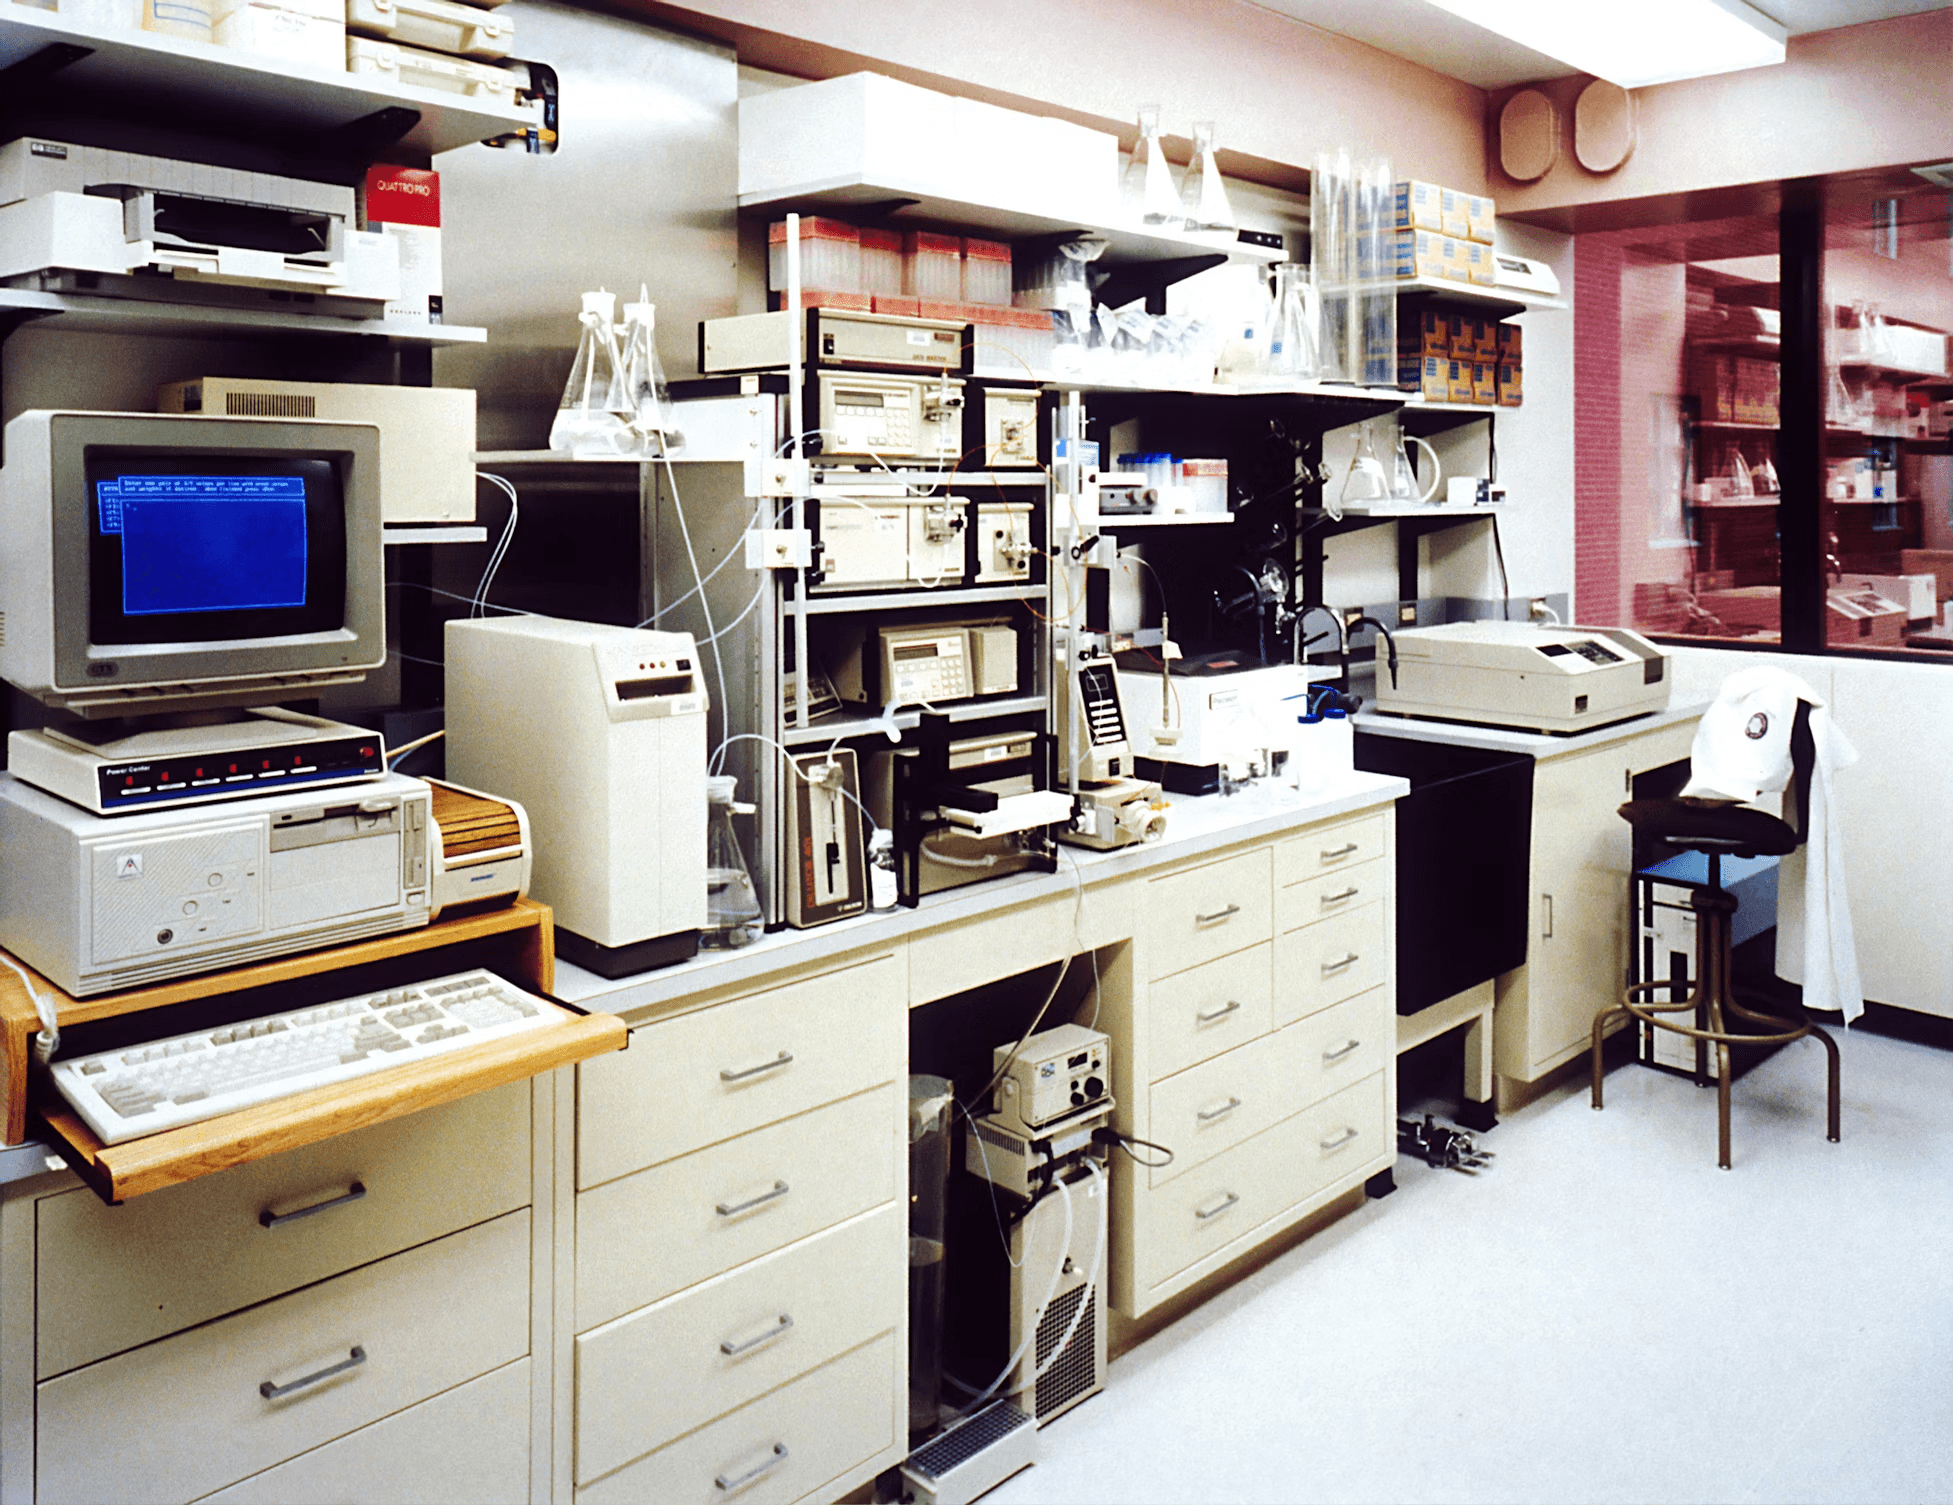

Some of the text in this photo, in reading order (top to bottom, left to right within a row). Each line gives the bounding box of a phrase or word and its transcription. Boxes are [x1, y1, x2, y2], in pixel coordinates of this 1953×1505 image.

[377, 179, 431, 197] QUATTRO PRO
[105, 765, 151, 776] Power Center
